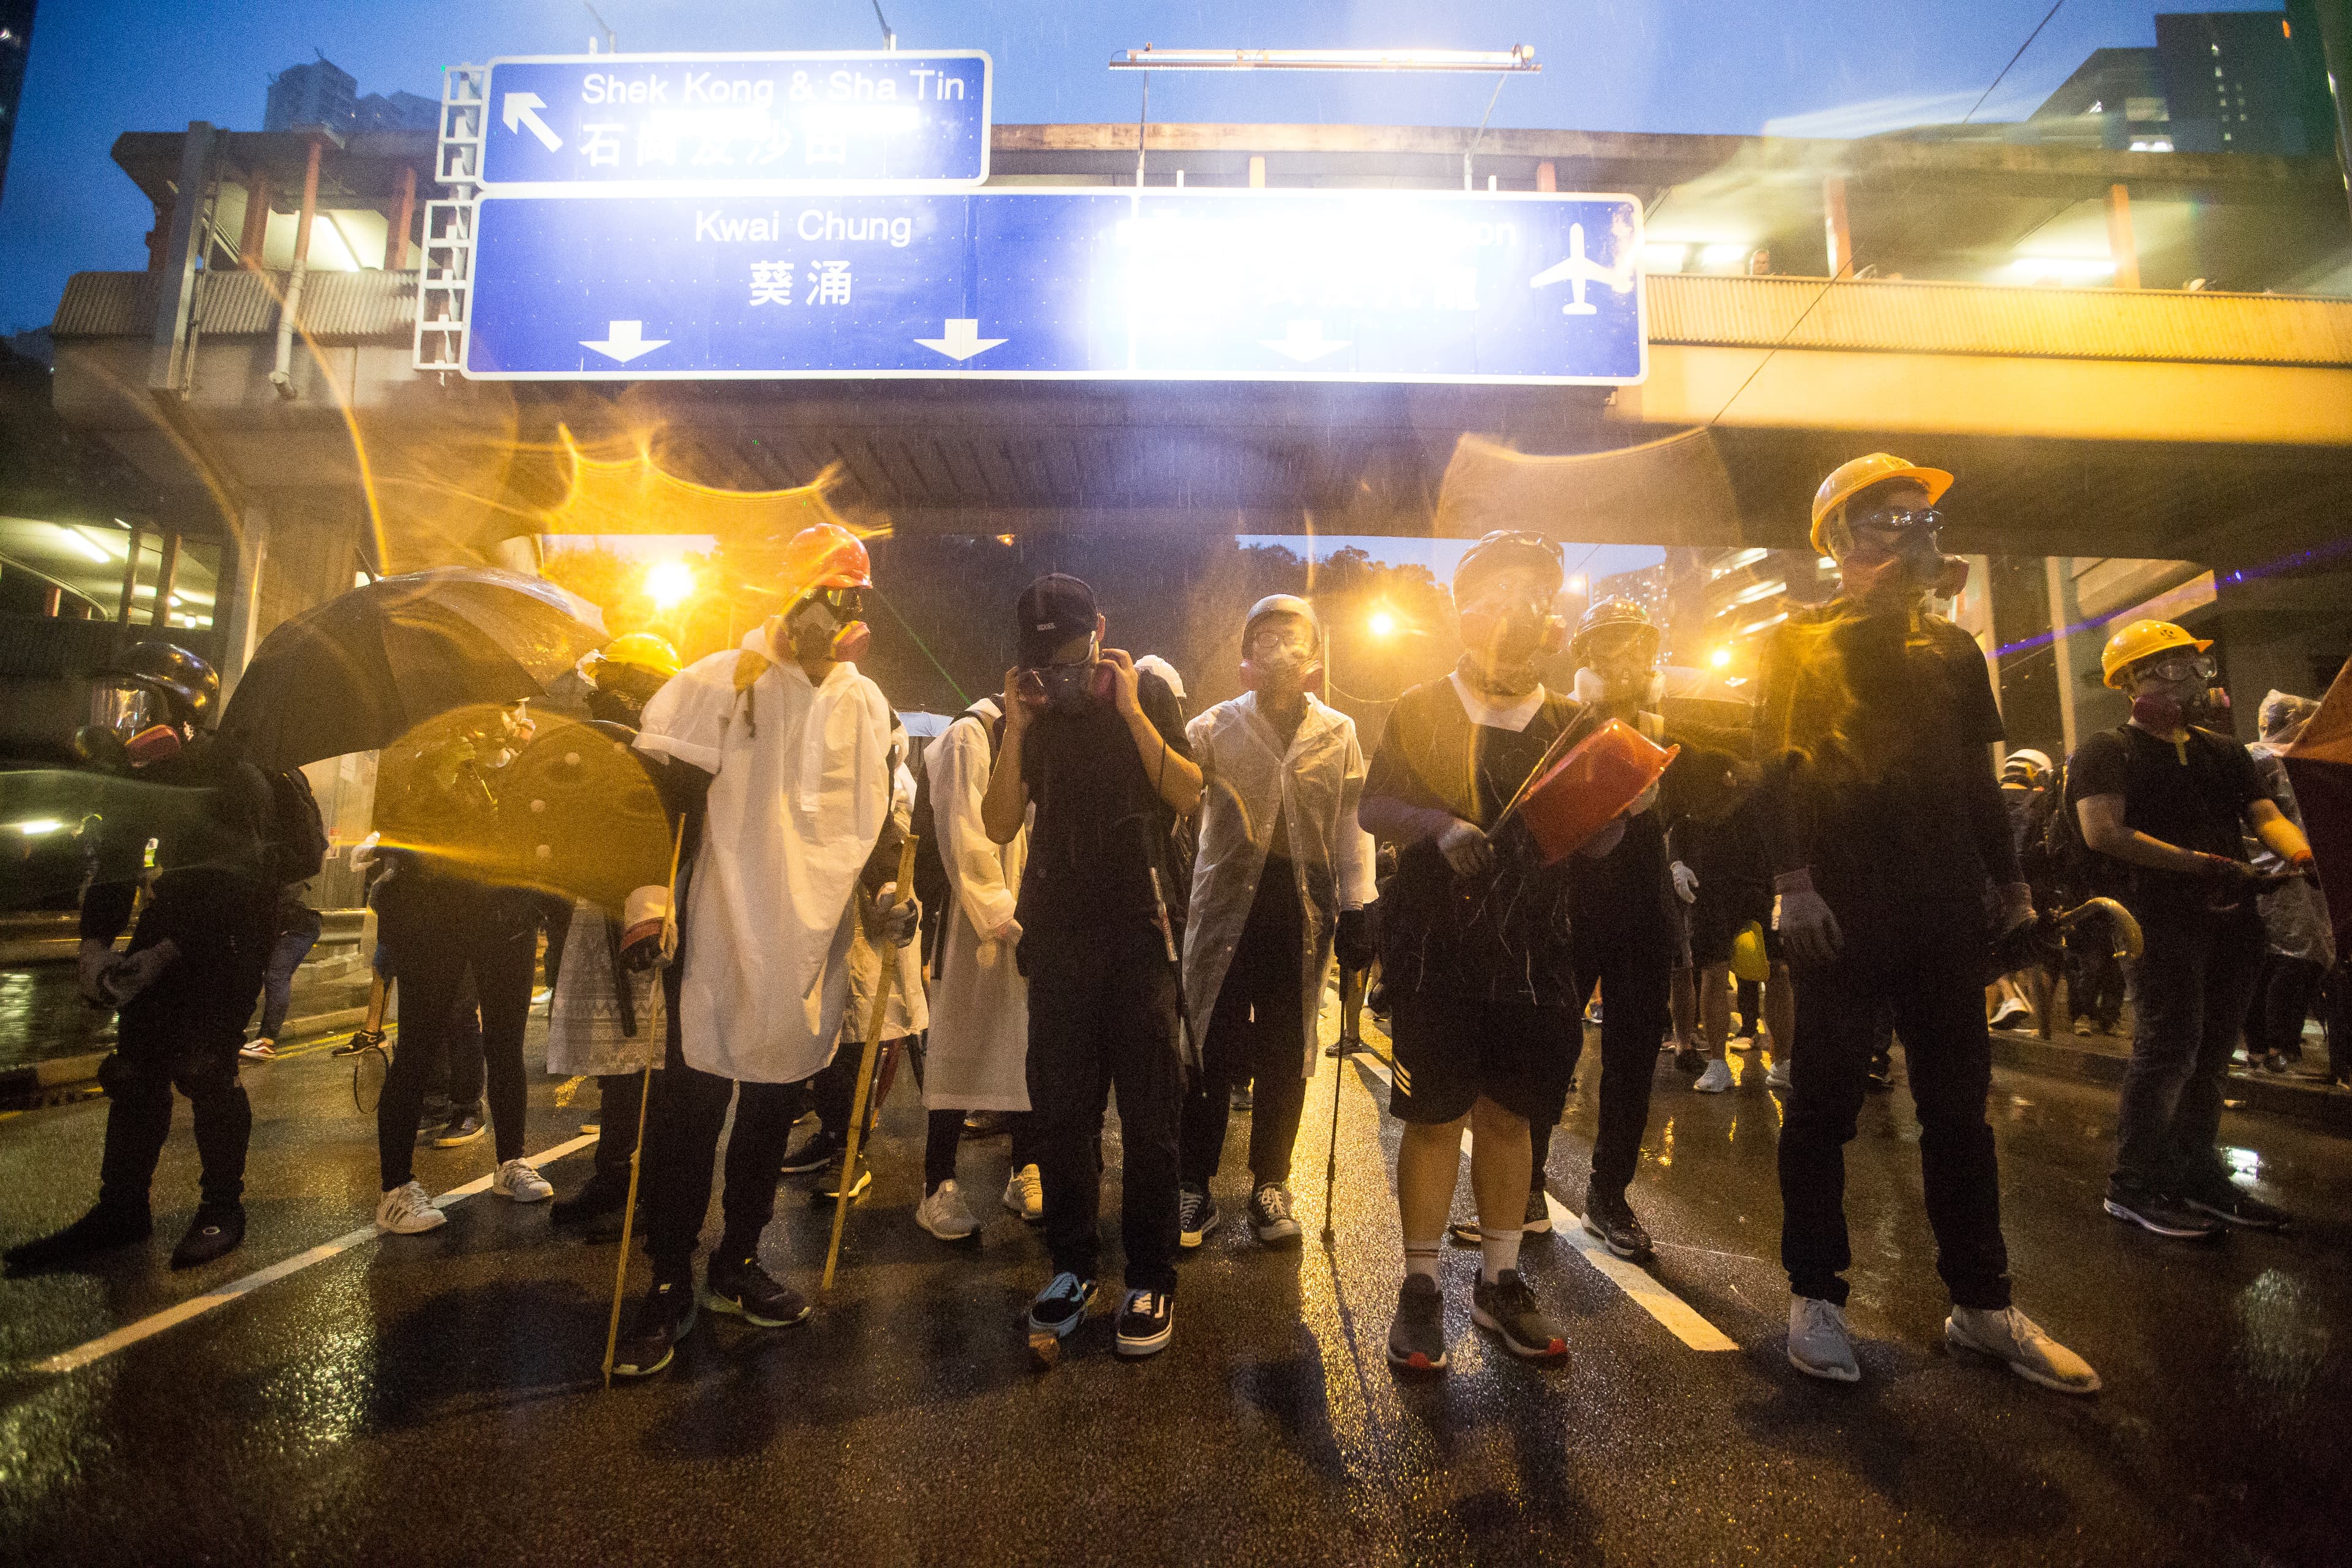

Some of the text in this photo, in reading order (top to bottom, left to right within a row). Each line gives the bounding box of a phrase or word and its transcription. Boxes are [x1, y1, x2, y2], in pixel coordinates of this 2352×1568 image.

[581, 69, 965, 107] Shek Kong & Sha Tin
[696, 210, 912, 247] Kwai Chung
[748, 260, 853, 306] 葵涌
